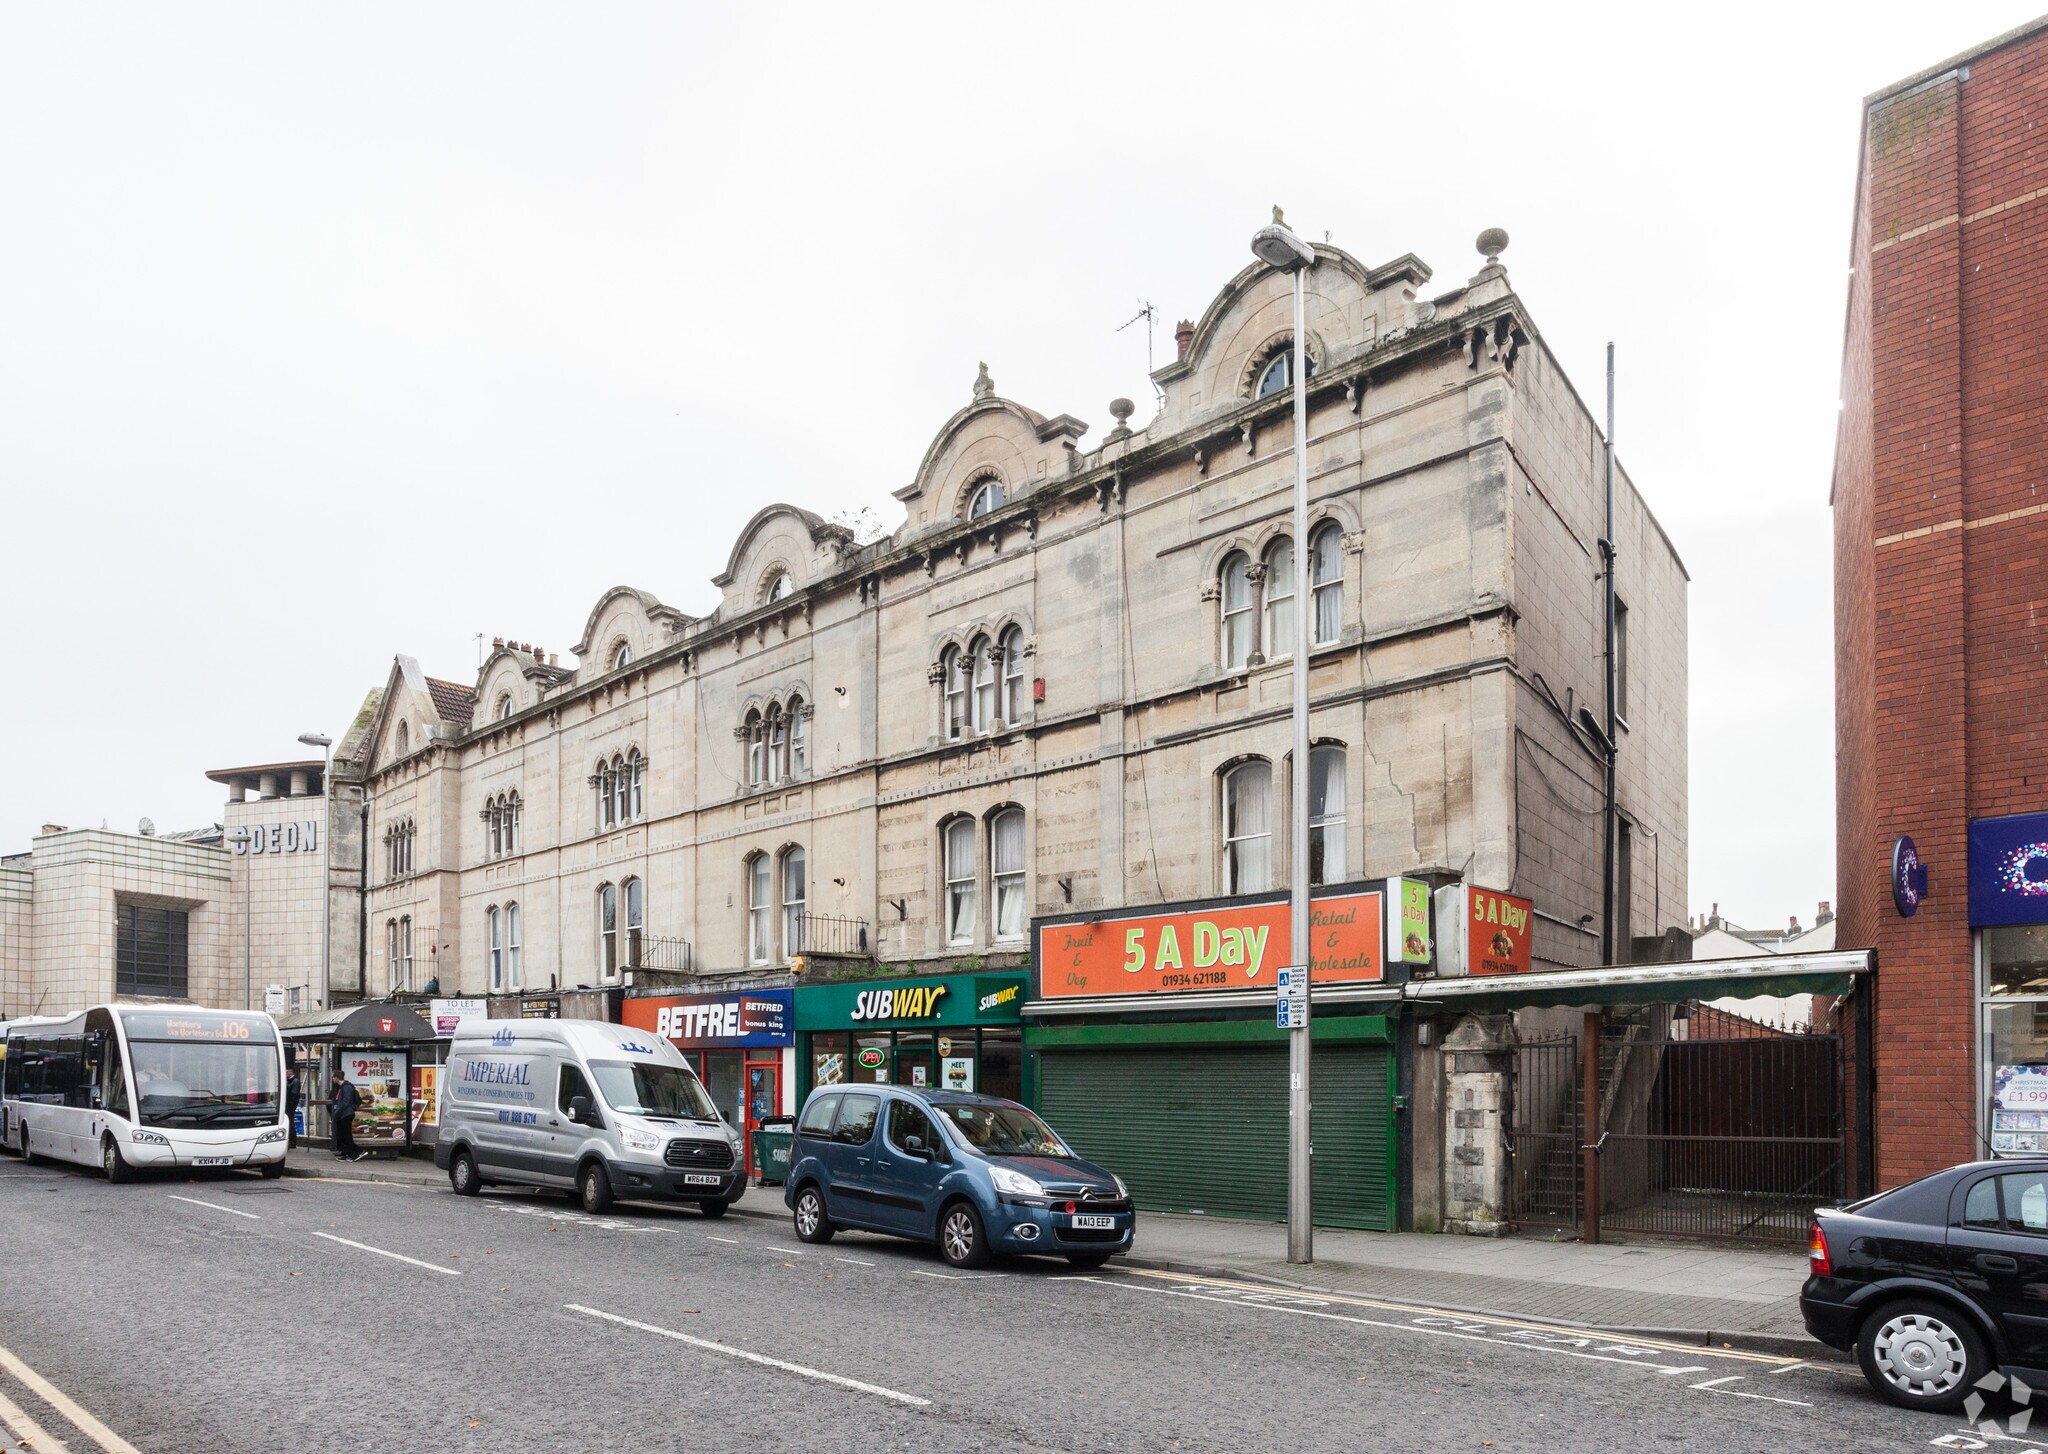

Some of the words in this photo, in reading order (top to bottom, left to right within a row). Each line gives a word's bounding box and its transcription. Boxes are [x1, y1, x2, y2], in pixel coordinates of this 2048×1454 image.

[234, 821, 316, 856] ODEON
[1411, 888, 1418, 904] 5
[1310, 908, 1356, 927] Retail
[1403, 906, 1409, 918] A
[1410, 907, 1426, 925] Day
[1474, 894, 1484, 921] 5
[1487, 897, 1498, 924] A
[1501, 900, 1528, 936] Day
[1062, 934, 1094, 952] Fruit
[1326, 931, 1340, 948] &
[1124, 928, 1146, 972] 5
[1154, 925, 1183, 970] A
[1193, 921, 1270, 978] Day
[1072, 952, 1083, 966] &
[1310, 952, 1372, 971] holesale
[1482, 960, 1498, 971] 01934
[1066, 972, 1088, 990] Veg
[1162, 973, 1191, 987] 01934
[1193, 972, 1226, 985] 621188
[745, 1002, 783, 1012] BETFRED
[850, 984, 946, 1020] SUBWAY
[979, 985, 1019, 1011] SUBWAY
[1280, 1000, 1287, 1011] P
[223, 1021, 249, 1039] 106
[862, 1052, 881, 1064] OPEN
[352, 1060, 378, 1076] £2.99
[464, 1061, 530, 1086] IMPERIAL
[458, 1086, 478, 1096] WINDOWS
[478, 1088, 482, 1096] &
[483, 1088, 523, 1100] CONSERVATORIES
[525, 1091, 535, 1101] LTD
[2008, 1092, 2048, 1102] £1.99
[498, 1110, 510, 1122] 0117
[511, 1112, 522, 1123] 986
[524, 1113, 537, 1124] 9714
[1078, 1217, 1095, 1226] WA13
[1097, 1218, 1110, 1226] EEP
[1170, 1285, 1330, 1306] KEEP
[1412, 1318, 1662, 1355] CLEAR
